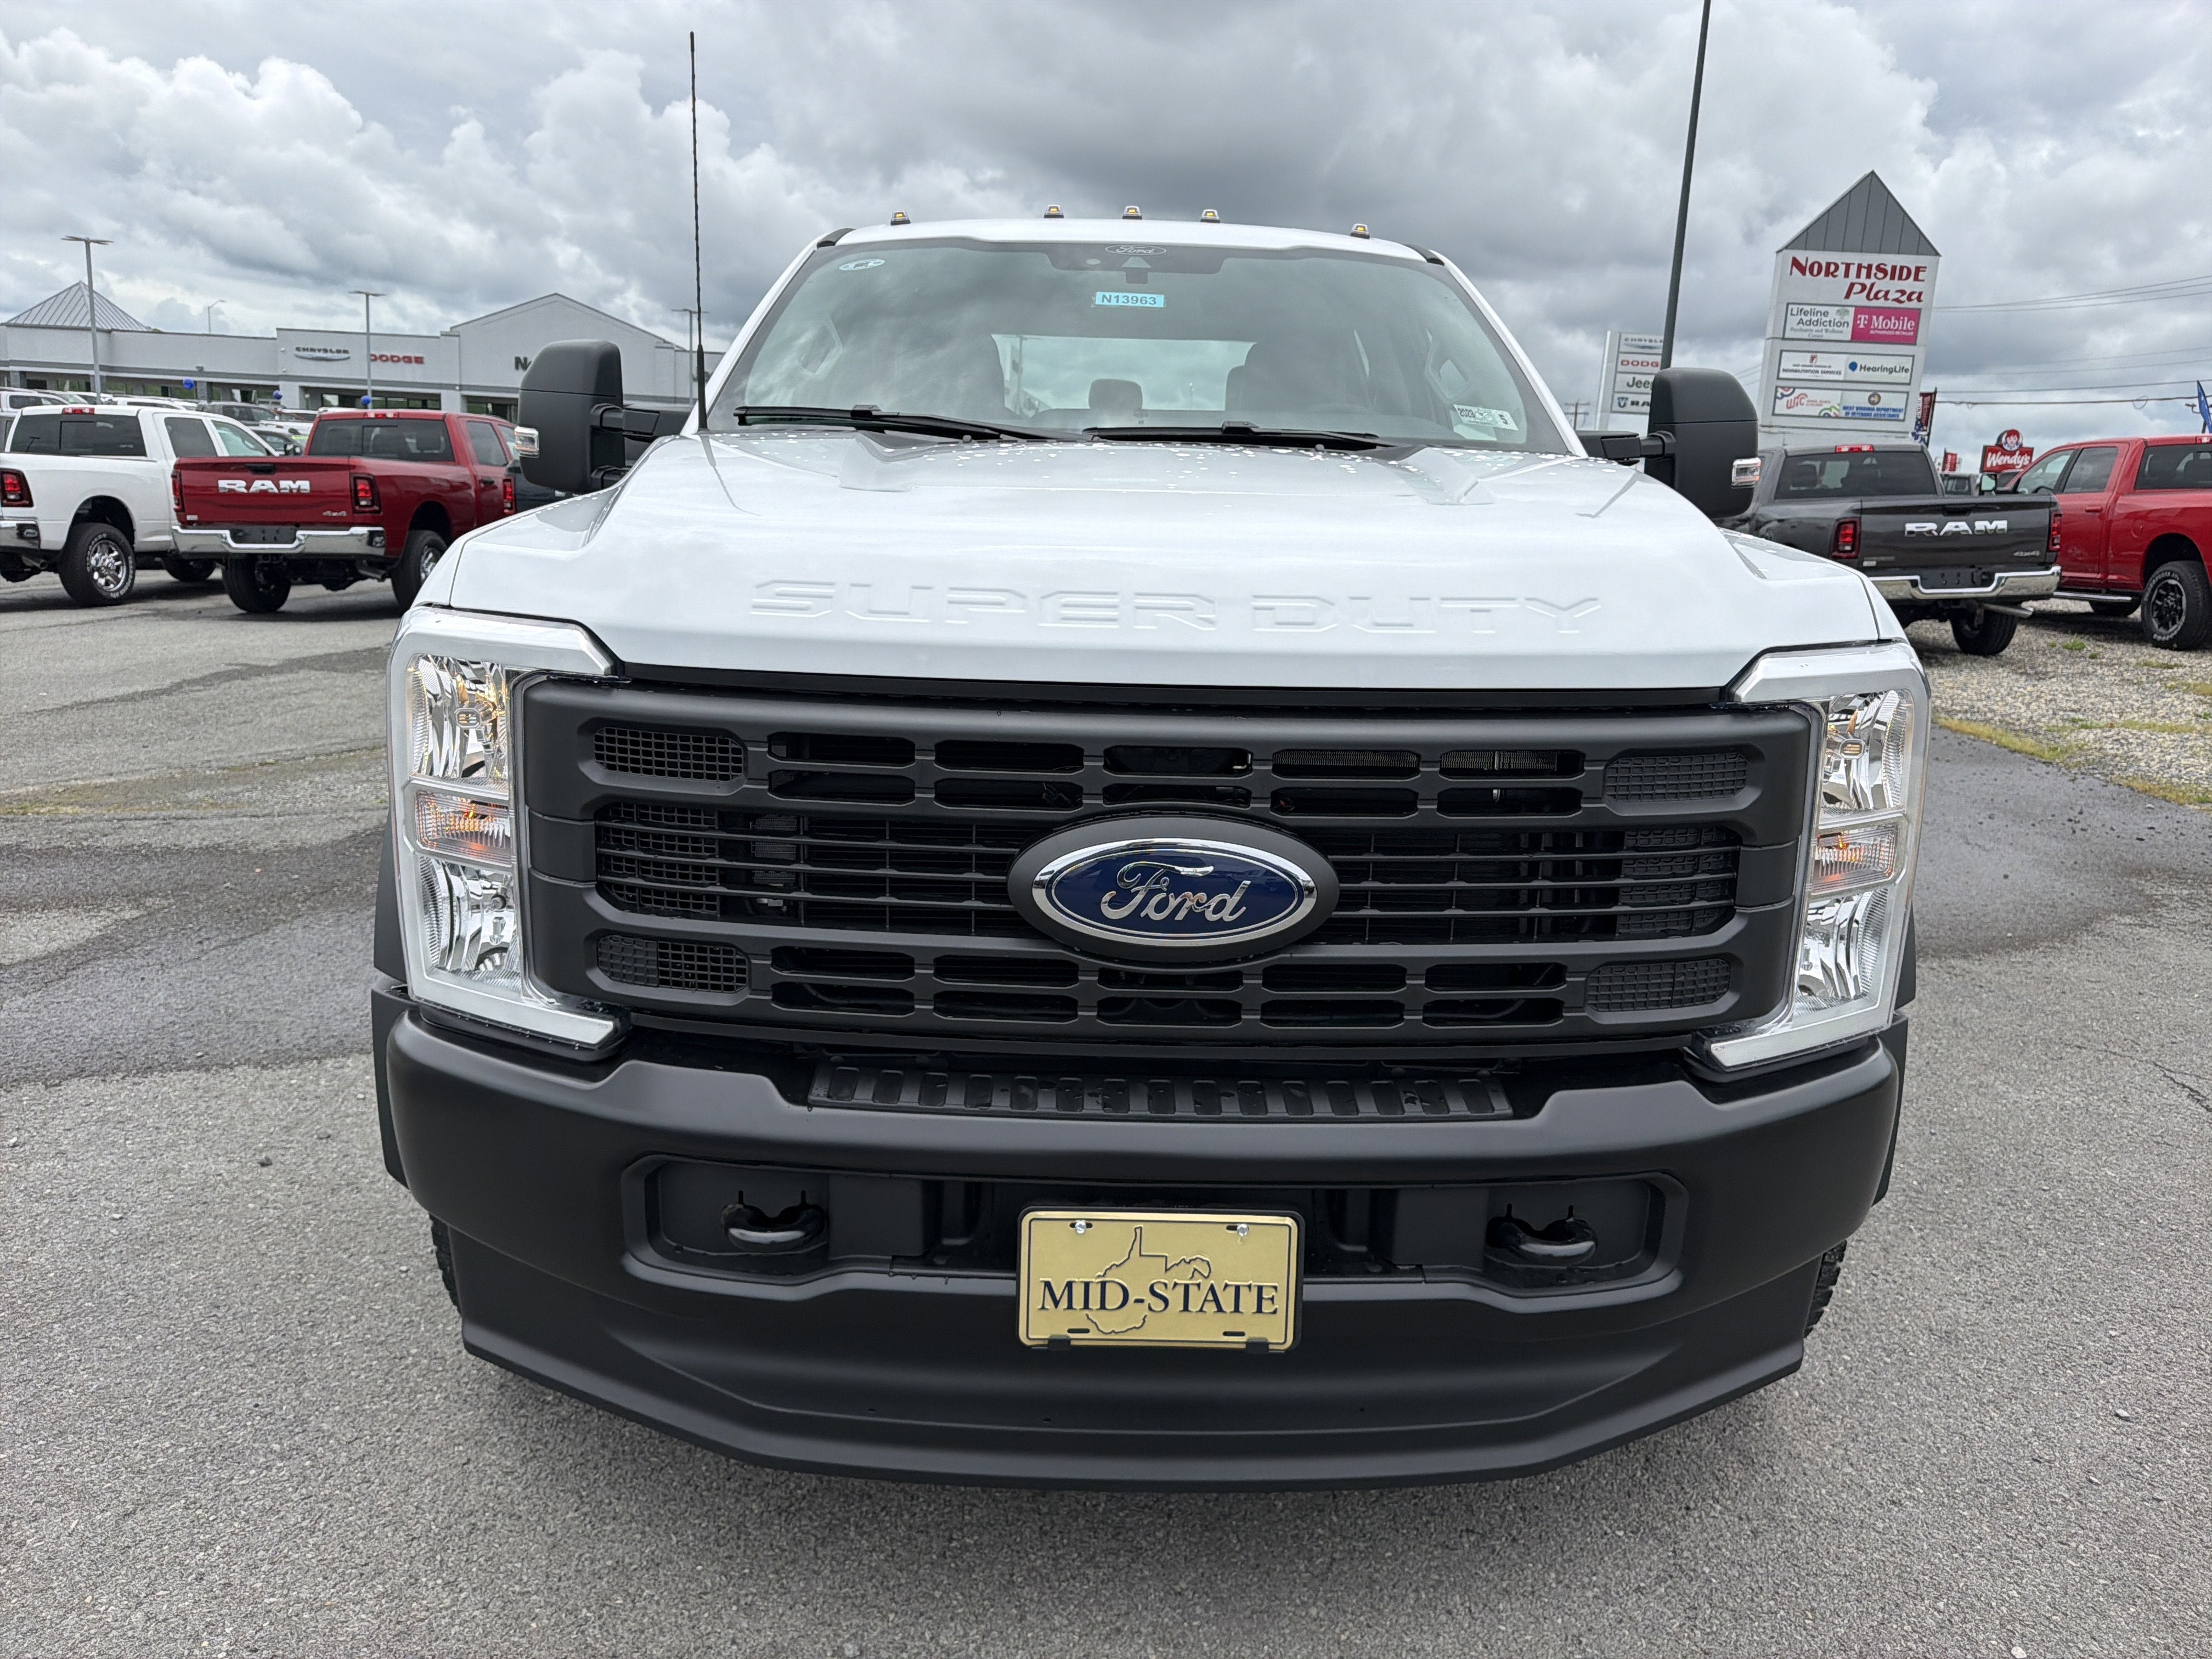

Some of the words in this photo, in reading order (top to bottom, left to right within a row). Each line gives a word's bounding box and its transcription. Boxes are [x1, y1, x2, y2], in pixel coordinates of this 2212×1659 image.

[1790, 256, 1927, 282] NORTHSIDE
[1101, 294, 1157, 305] N13963
[1844, 282, 1924, 304] Plaza
[1790, 307, 1830, 318] Lifeline
[1796, 318, 1850, 329] Addiction
[1857, 314, 1868, 328] T
[1870, 315, 1915, 330] Mobile
[1621, 359, 1659, 368] DODG
[1859, 364, 1910, 375] HearingLife
[1627, 376, 1653, 389] Jee
[1498, 414, 1509, 425] 5
[1987, 450, 2030, 469] Wendy's
[217, 479, 311, 494] RAM
[1904, 520, 2008, 537] RAM
[750, 579, 1217, 631] SUPER
[1250, 595, 1602, 634] DUTY
[1100, 861, 1251, 923] Ford
[1037, 1278, 1278, 1314] MID-STATE
